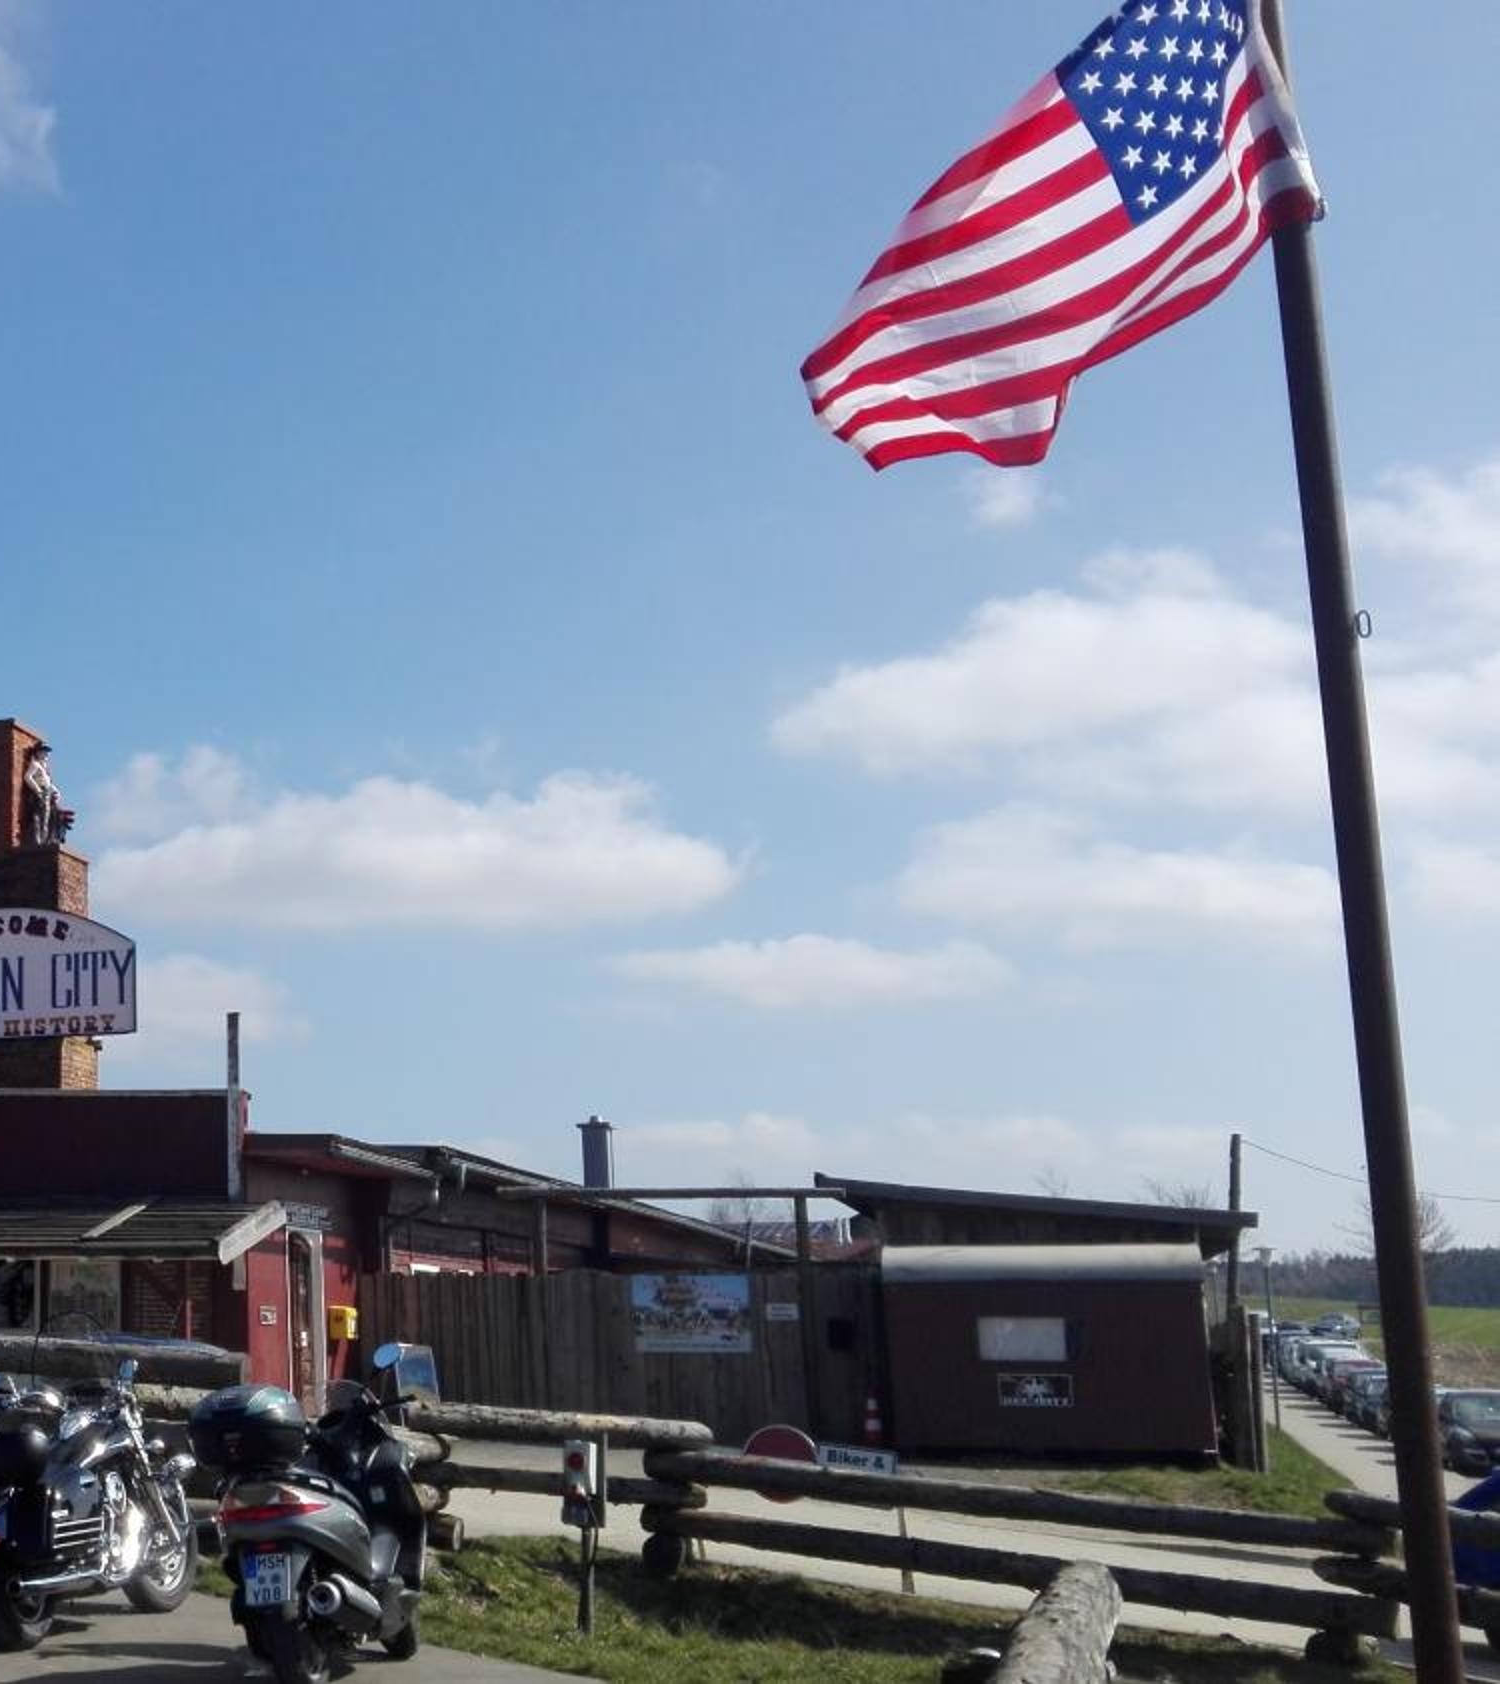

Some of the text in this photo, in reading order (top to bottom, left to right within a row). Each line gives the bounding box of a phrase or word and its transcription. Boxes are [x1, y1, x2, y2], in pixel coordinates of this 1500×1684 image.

[51, 950, 134, 1009] CITY
[3, 1014, 116, 1037] HISTORY
[827, 1450, 869, 1467] Biker
